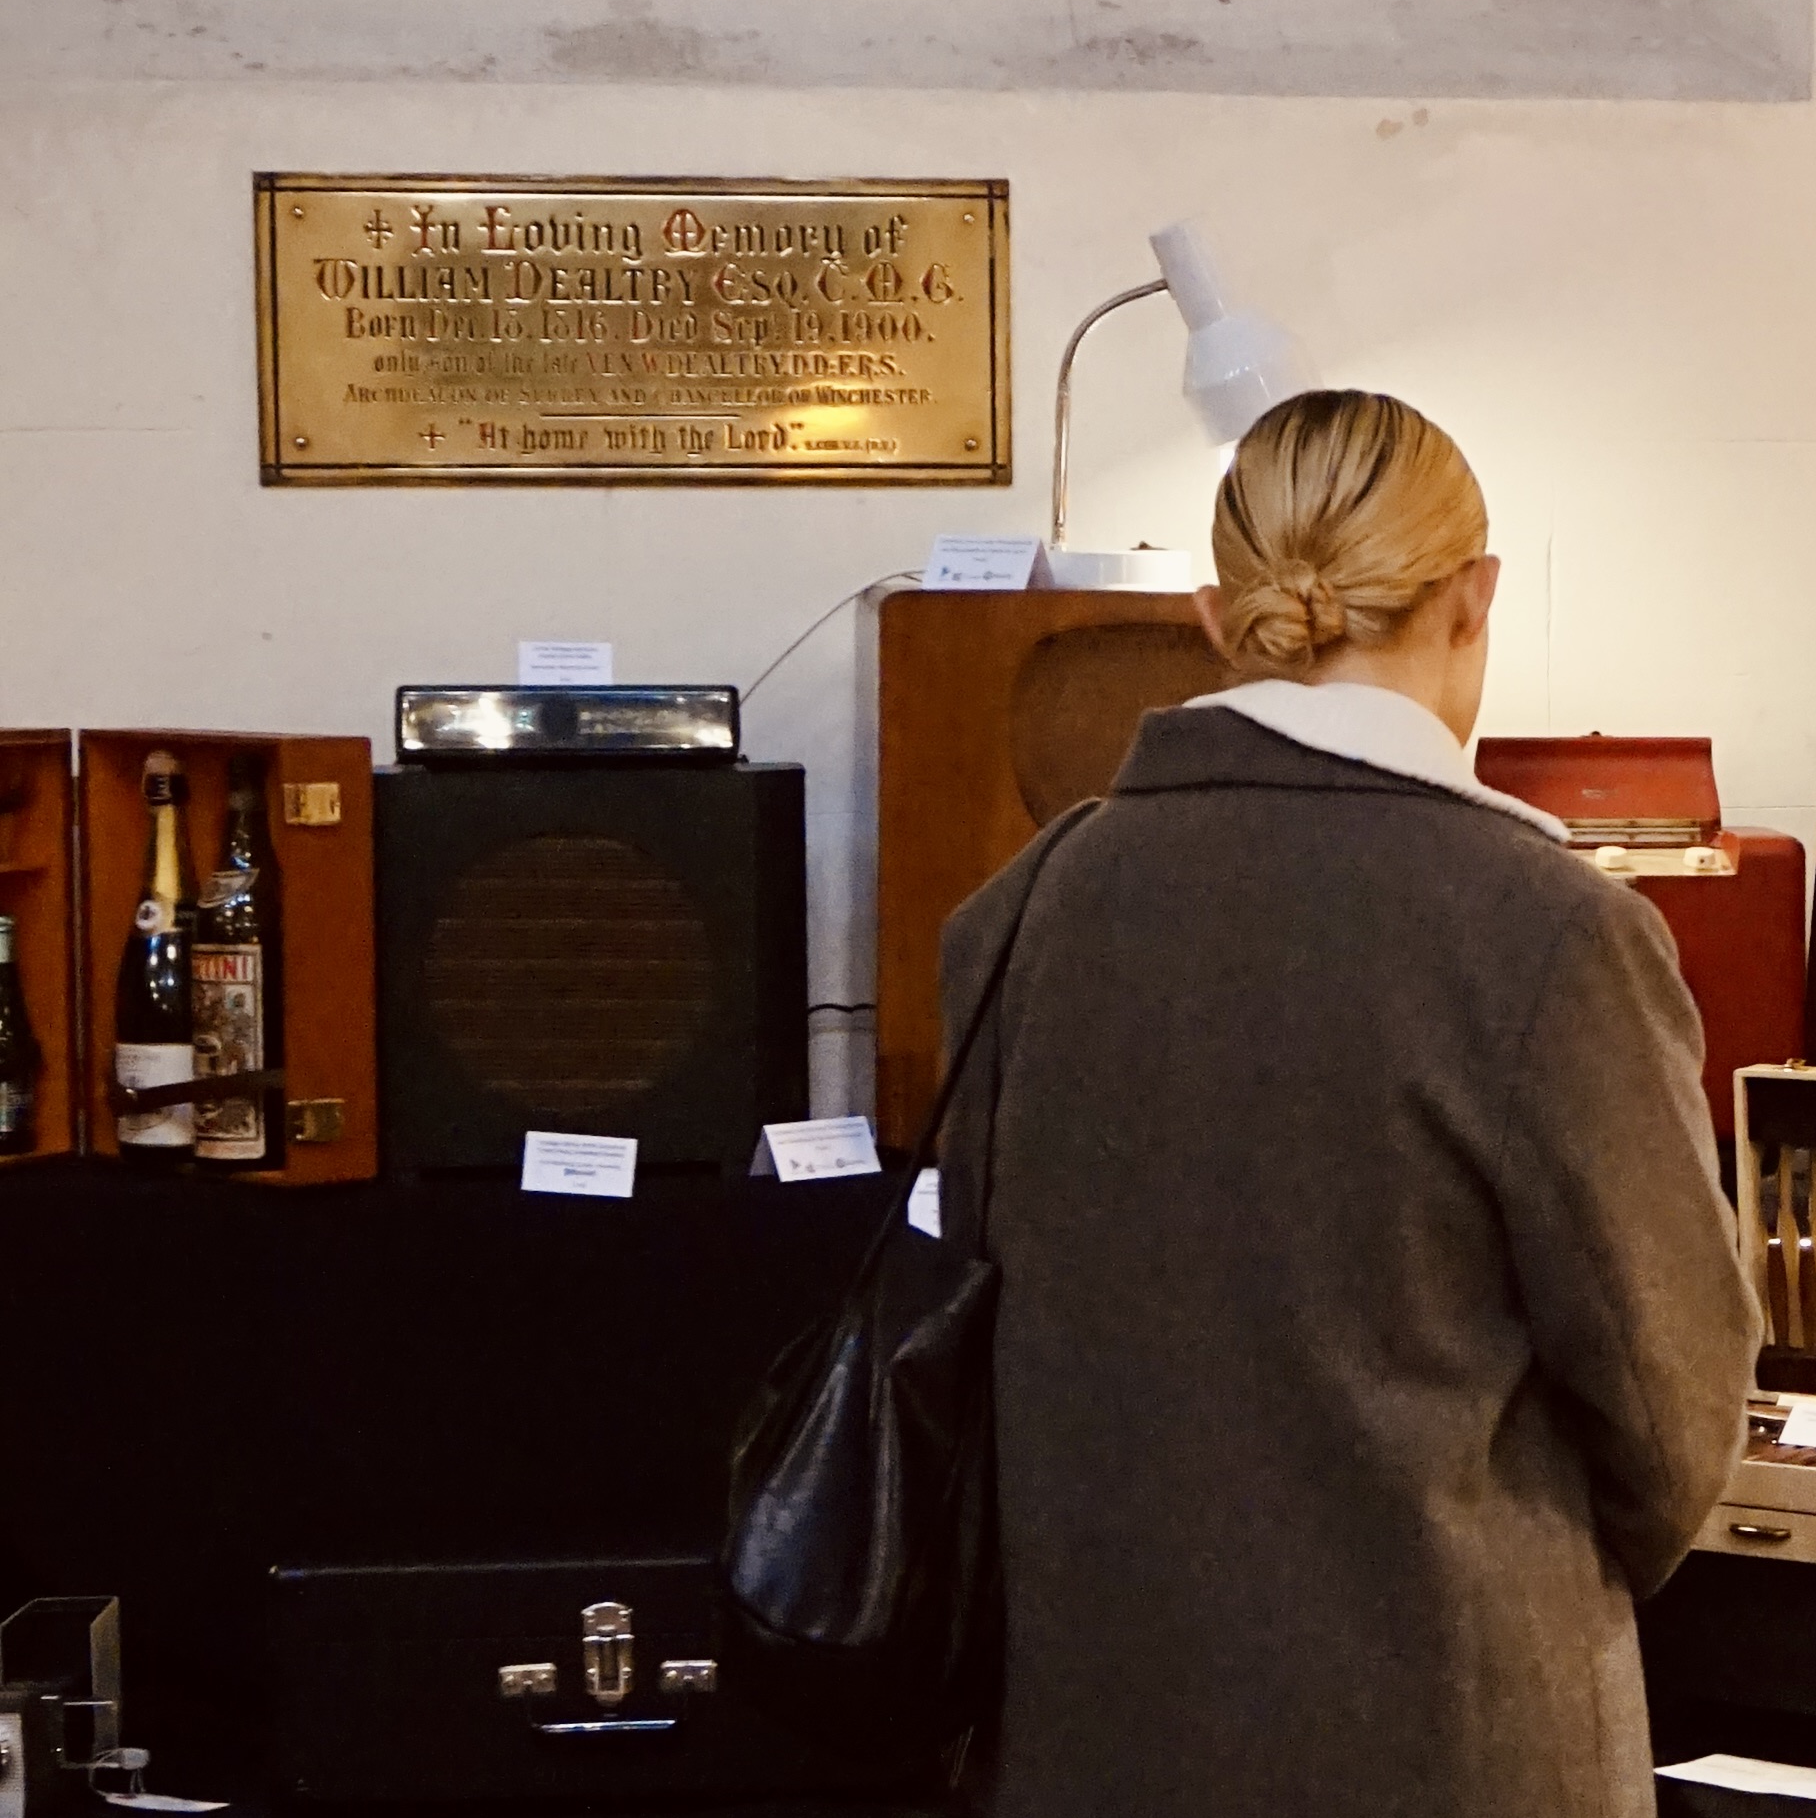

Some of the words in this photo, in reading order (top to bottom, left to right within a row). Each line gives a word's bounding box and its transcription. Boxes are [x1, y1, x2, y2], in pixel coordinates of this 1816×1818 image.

[410, 203, 461, 256] In
[475, 204, 643, 265] Loving
[662, 207, 845, 263] Memory
[862, 214, 907, 258] of
[313, 258, 494, 303] WILLIAM
[503, 259, 697, 305] DEALTRY
[344, 306, 417, 341] Born
[628, 310, 698, 345] Died
[519, 423, 588, 455] home
[603, 422, 667, 455] with
[678, 422, 714, 457] the
